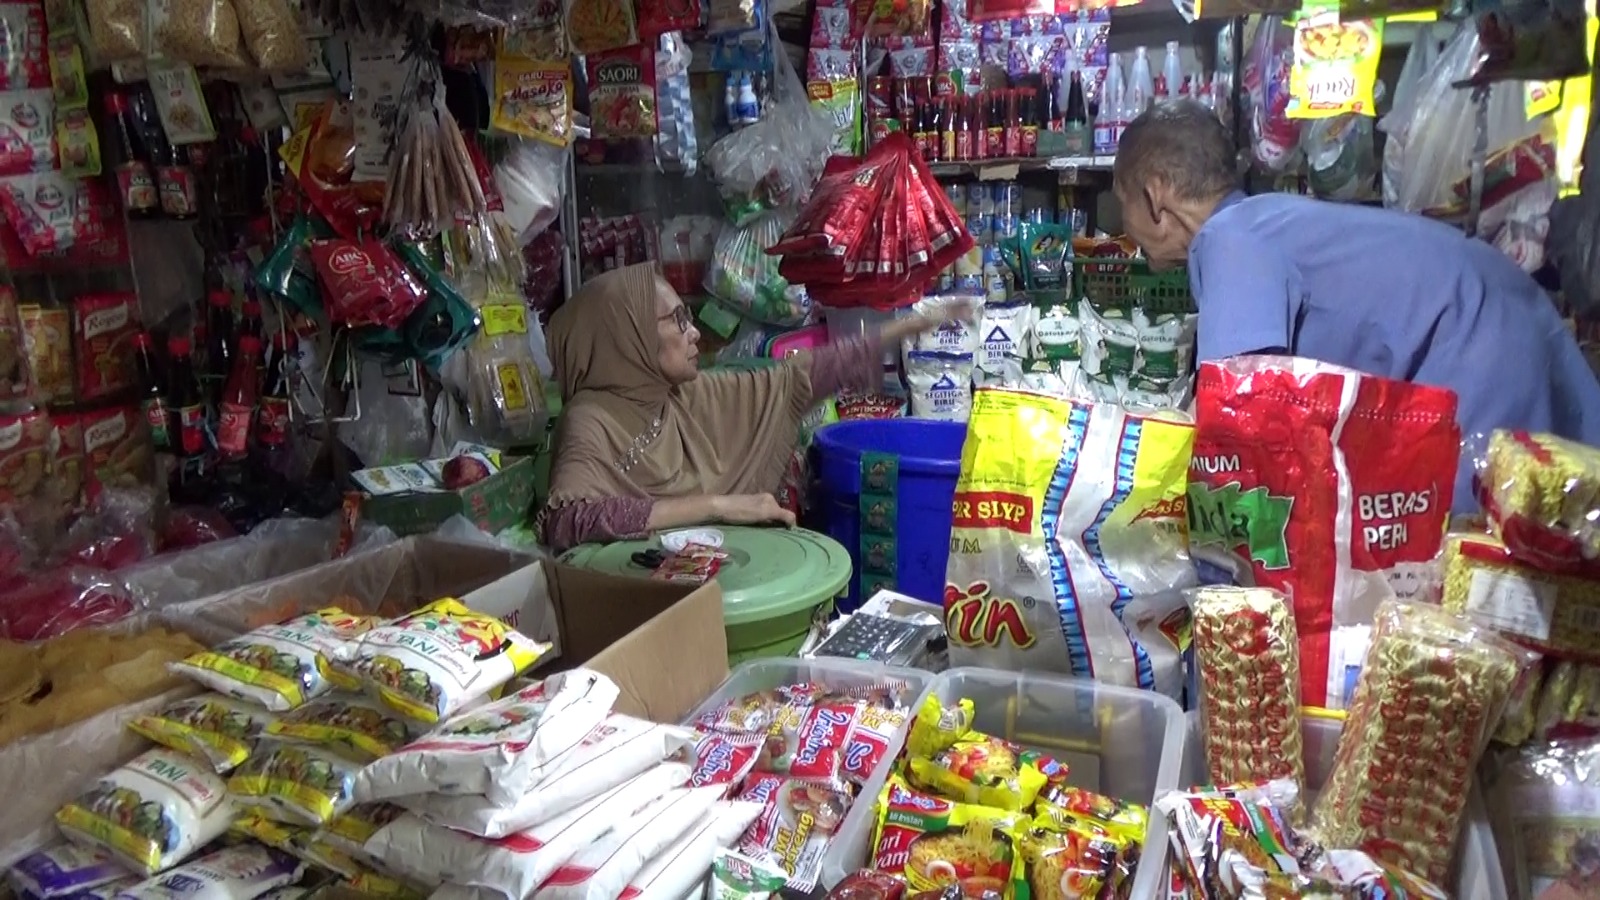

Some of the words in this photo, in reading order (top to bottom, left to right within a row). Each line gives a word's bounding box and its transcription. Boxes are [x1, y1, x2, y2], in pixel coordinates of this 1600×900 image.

[598, 67, 638, 82] SAORI
[509, 79, 564, 100] Masako
[979, 342, 1017, 351] SEGITIGA
[924, 391, 964, 400] SEGITIGA
[934, 398, 955, 407] BIRU
[977, 500, 1027, 523] SLYP
[1358, 489, 1431, 521] BERAS
[396, 633, 440, 656] TANI
[146, 759, 188, 782] TANI
[879, 830, 902, 851] ari
[876, 851, 909, 870] yam
